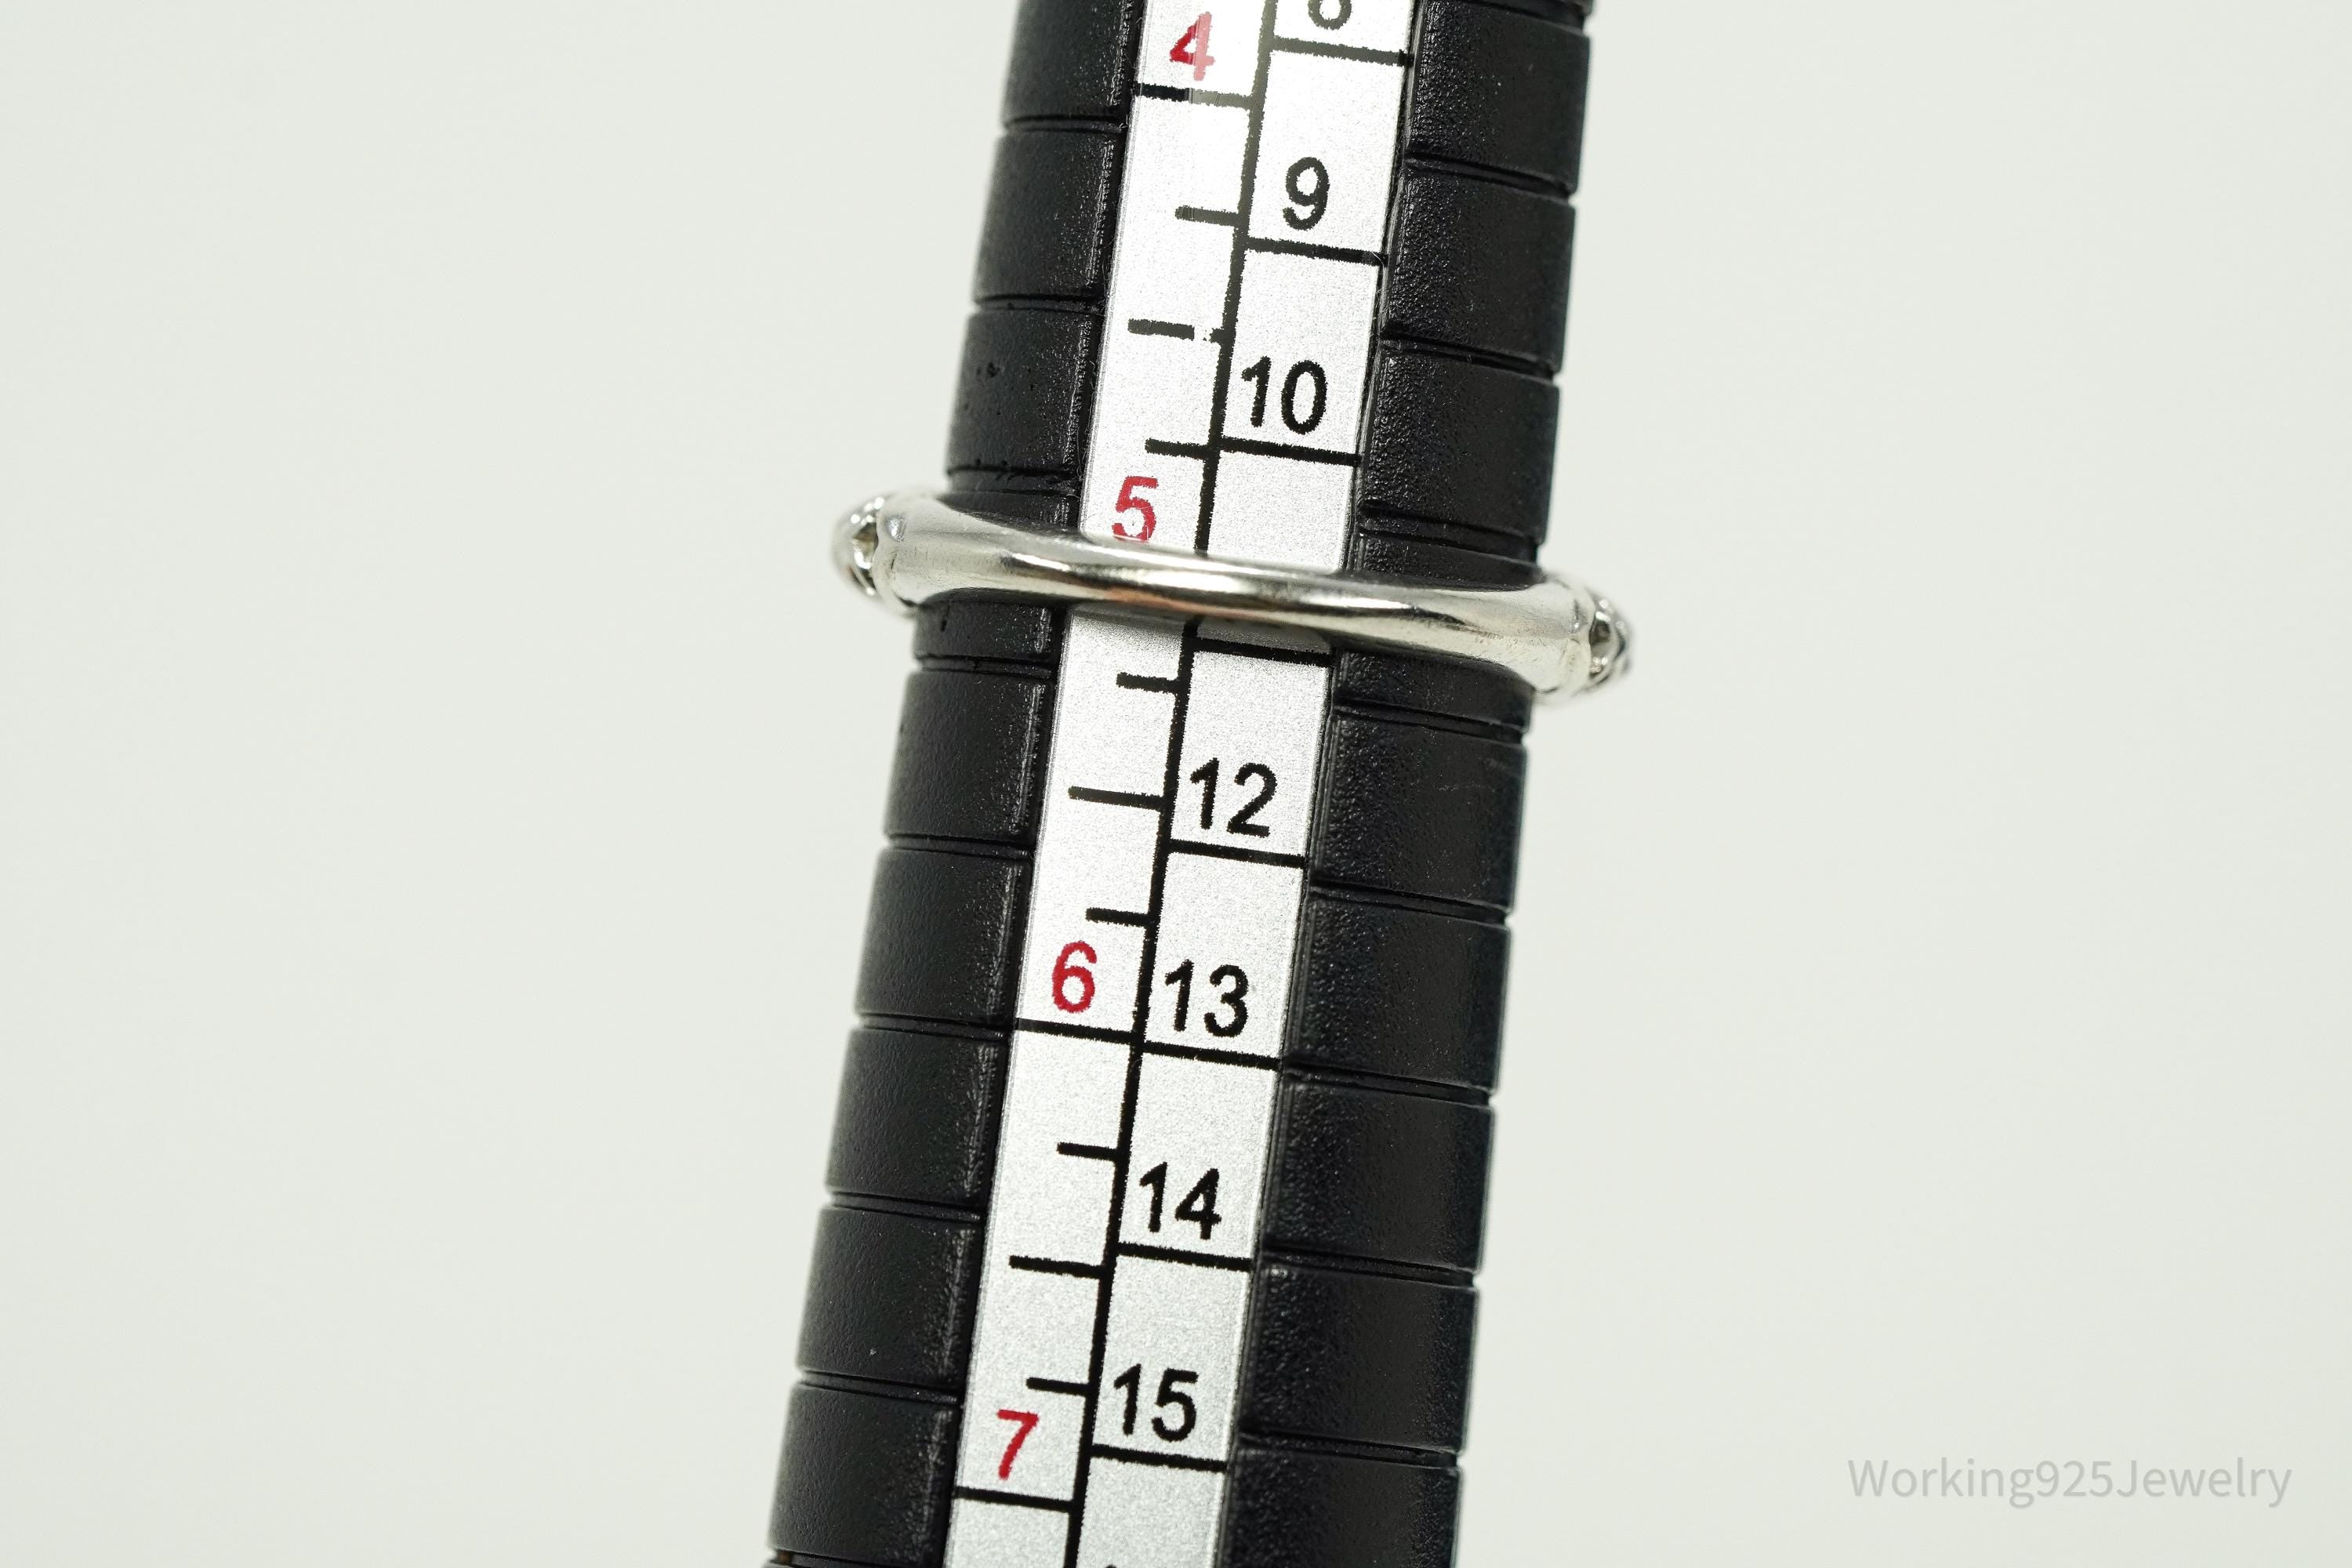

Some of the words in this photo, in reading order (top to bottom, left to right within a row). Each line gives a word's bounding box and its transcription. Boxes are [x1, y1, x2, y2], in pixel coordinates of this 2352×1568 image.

[1170, 11, 1215, 81] 4
[1283, 157, 1330, 230] 9
[1241, 356, 1328, 434] 10
[1112, 476, 1159, 542] 5
[1190, 757, 1278, 837] 12
[1052, 940, 1097, 1014] 6
[1165, 959, 1249, 1037] 13
[1139, 1162, 1221, 1240] 14
[1114, 1363, 1199, 1443] 15
[996, 1409, 1039, 1480] 7
